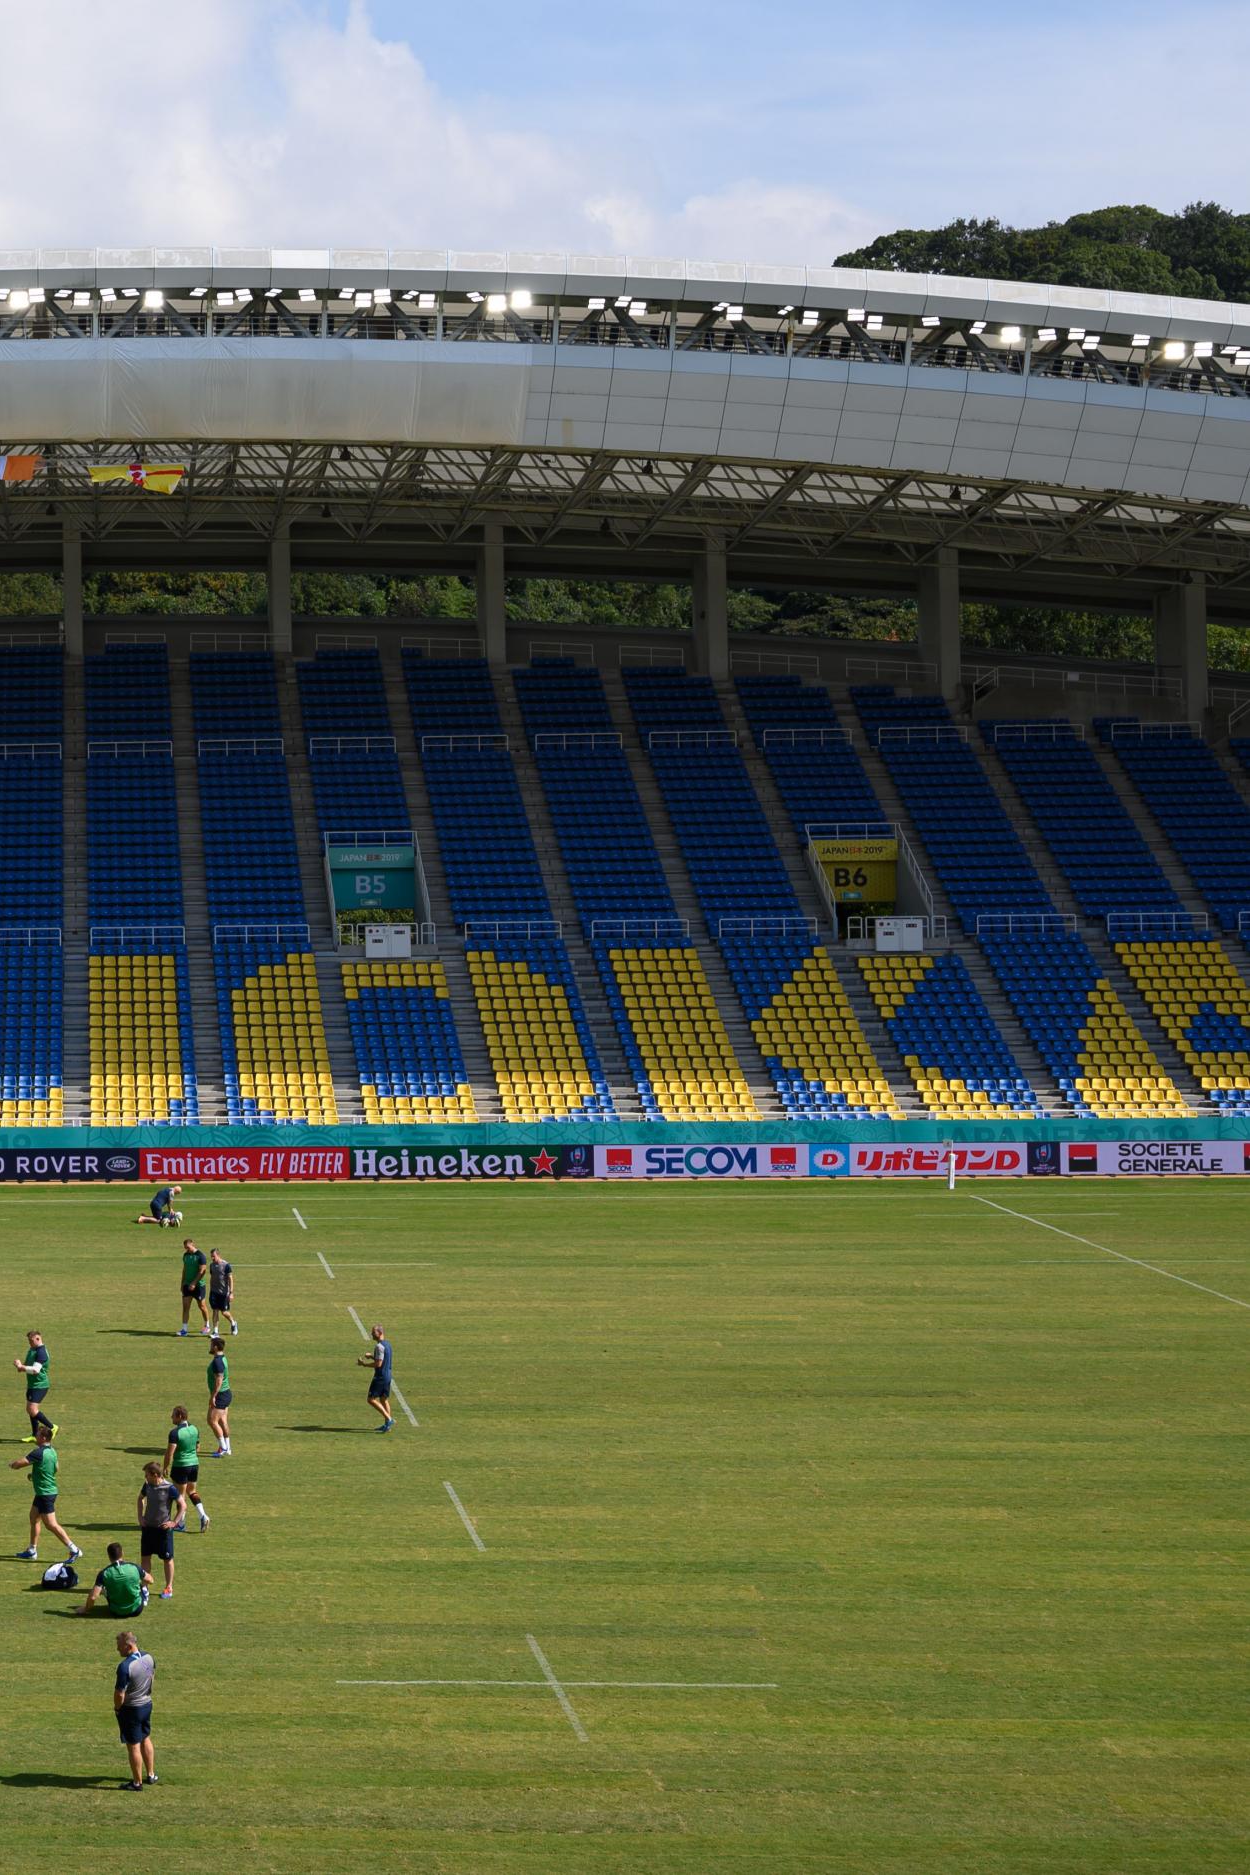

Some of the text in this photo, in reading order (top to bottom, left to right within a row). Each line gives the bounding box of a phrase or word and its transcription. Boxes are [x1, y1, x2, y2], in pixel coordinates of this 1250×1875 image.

[355, 875, 386, 894] B5
[834, 868, 868, 887] B6
[856, 1147, 1021, 1171] リポビタンD
[1117, 1143, 1204, 1156] SOCIETE
[16, 1156, 100, 1174] ROVER
[145, 1151, 345, 1175] Emirates FLY BETTER
[353, 1148, 525, 1177] Heineken
[645, 1146, 757, 1175] SECOM
[821, 1153, 838, 1166] D
[1117, 1158, 1224, 1172] GENERALE
